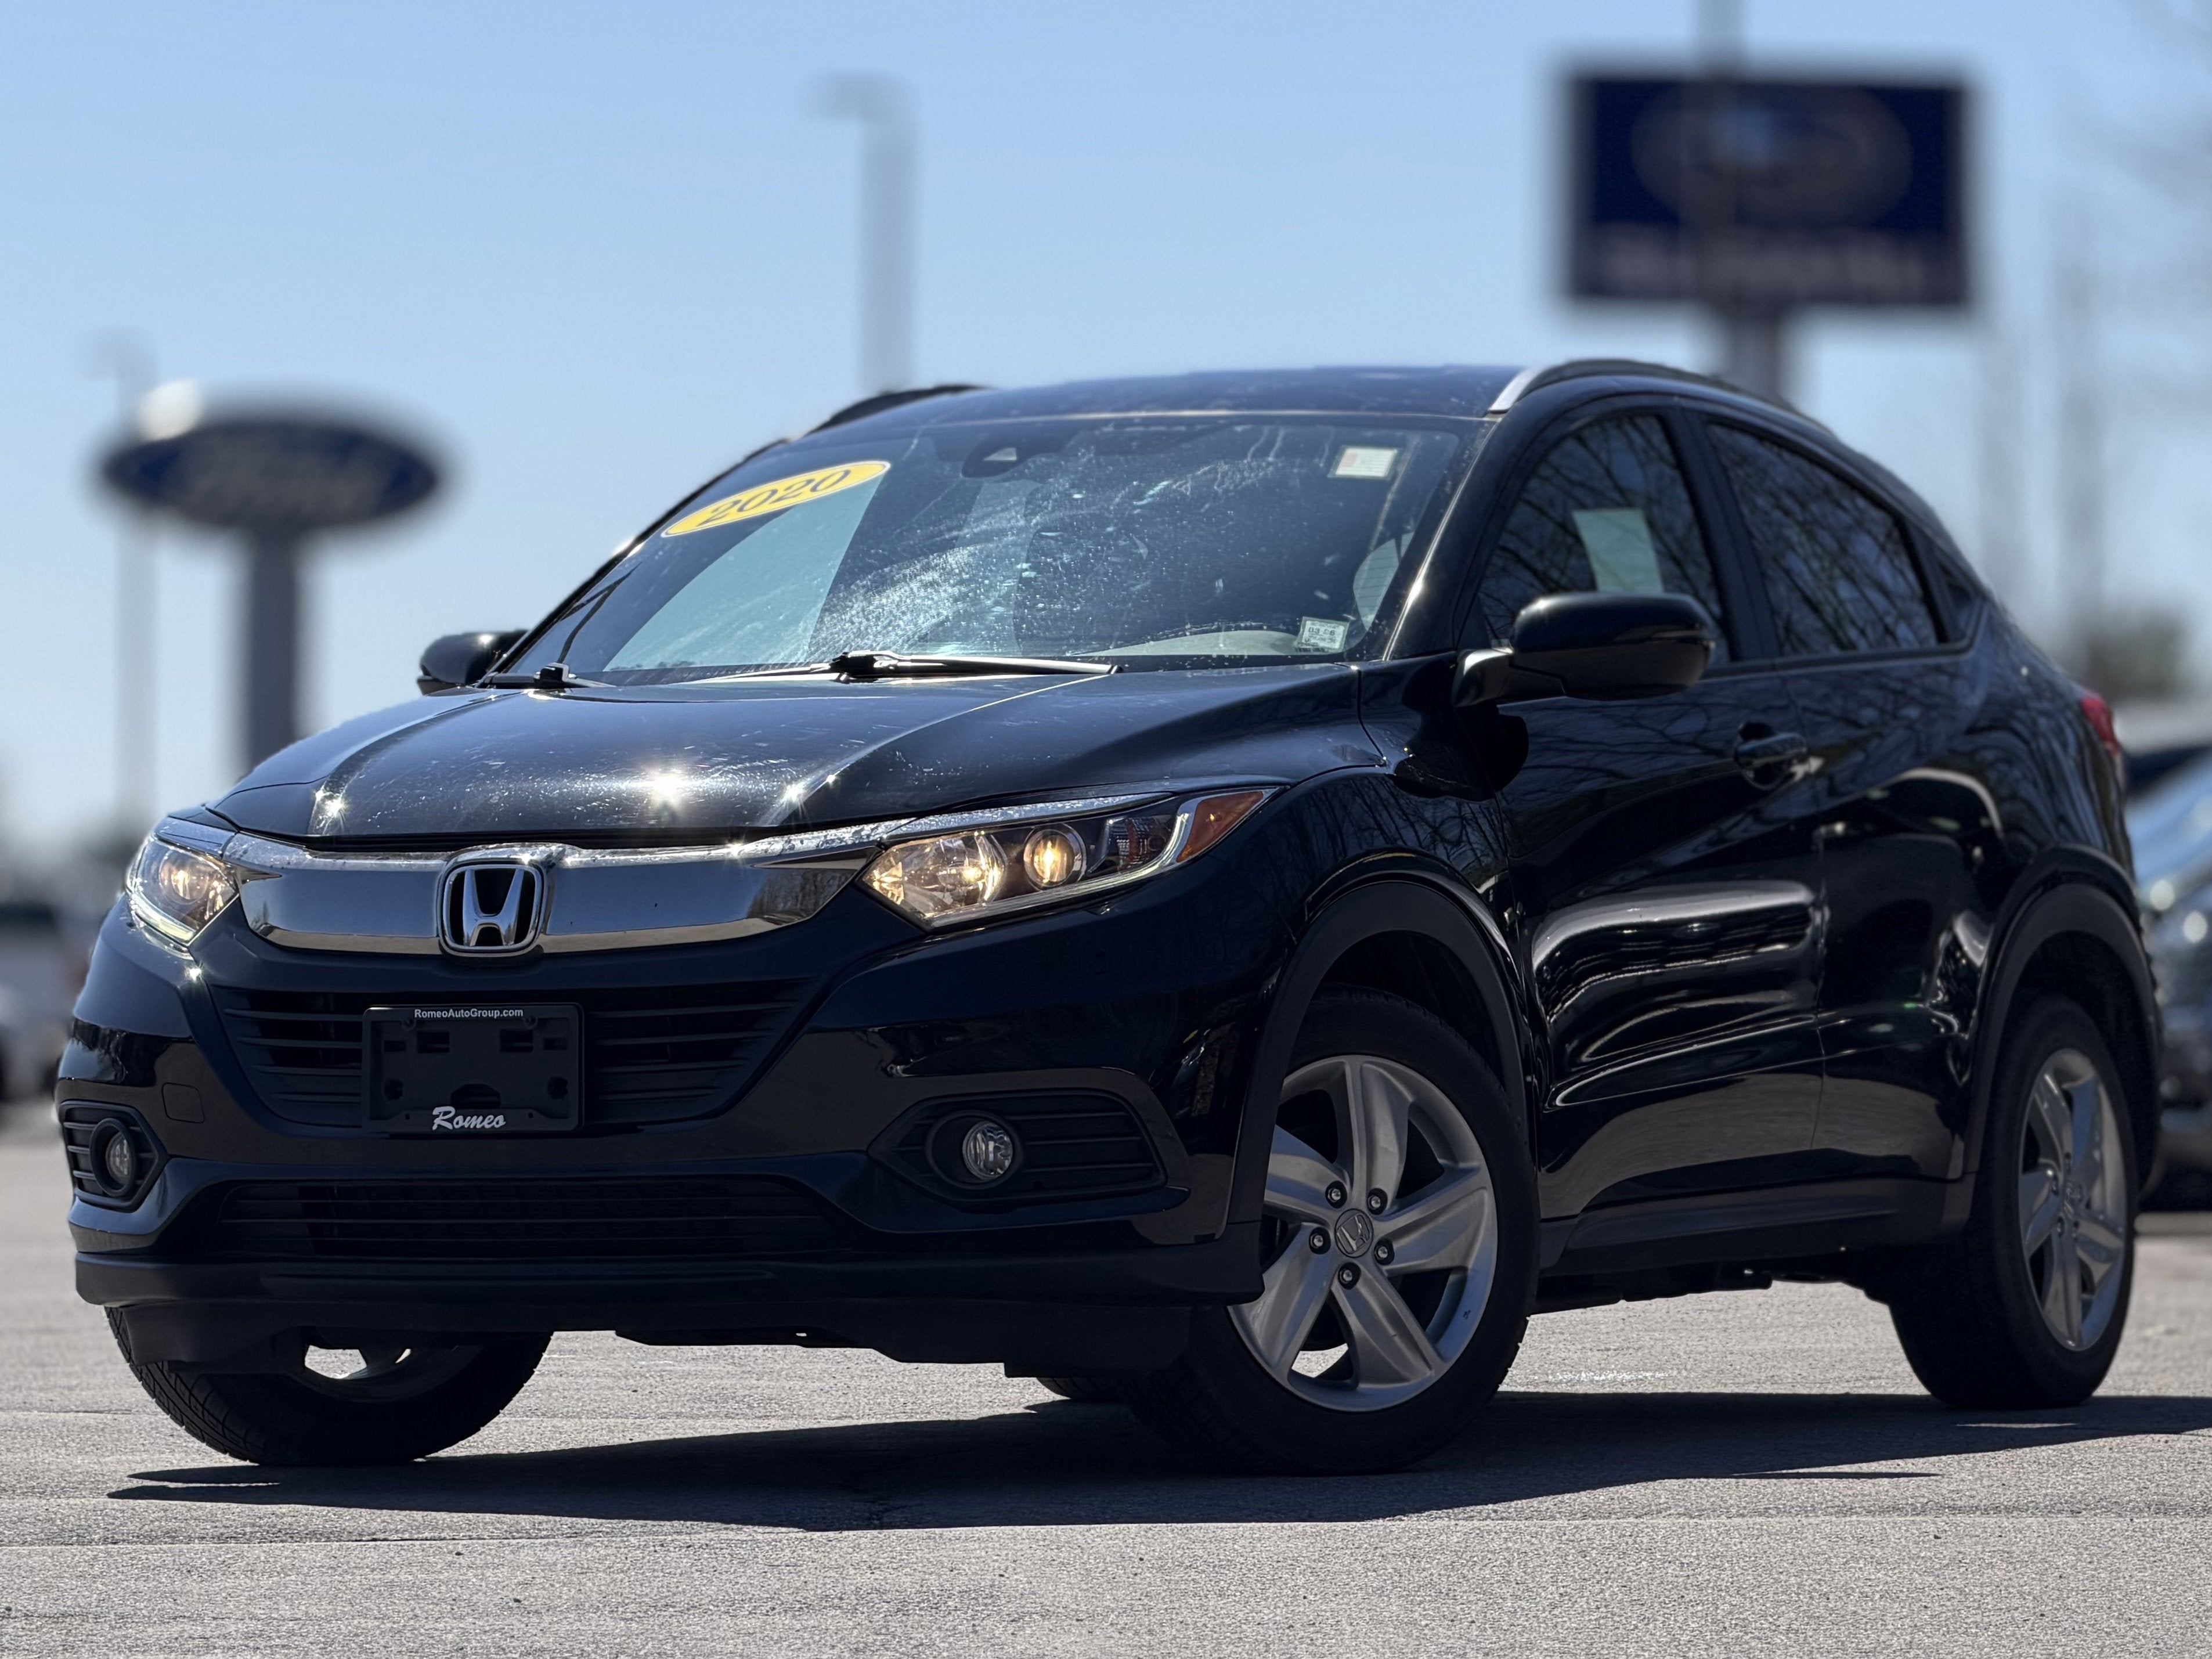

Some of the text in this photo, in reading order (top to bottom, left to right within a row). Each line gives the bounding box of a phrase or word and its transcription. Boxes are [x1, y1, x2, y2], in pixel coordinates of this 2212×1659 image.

[697, 469, 851, 527] 2020
[414, 1008, 523, 1019] RomeoAutoGroup.com
[432, 1106, 506, 1130] Romeo
